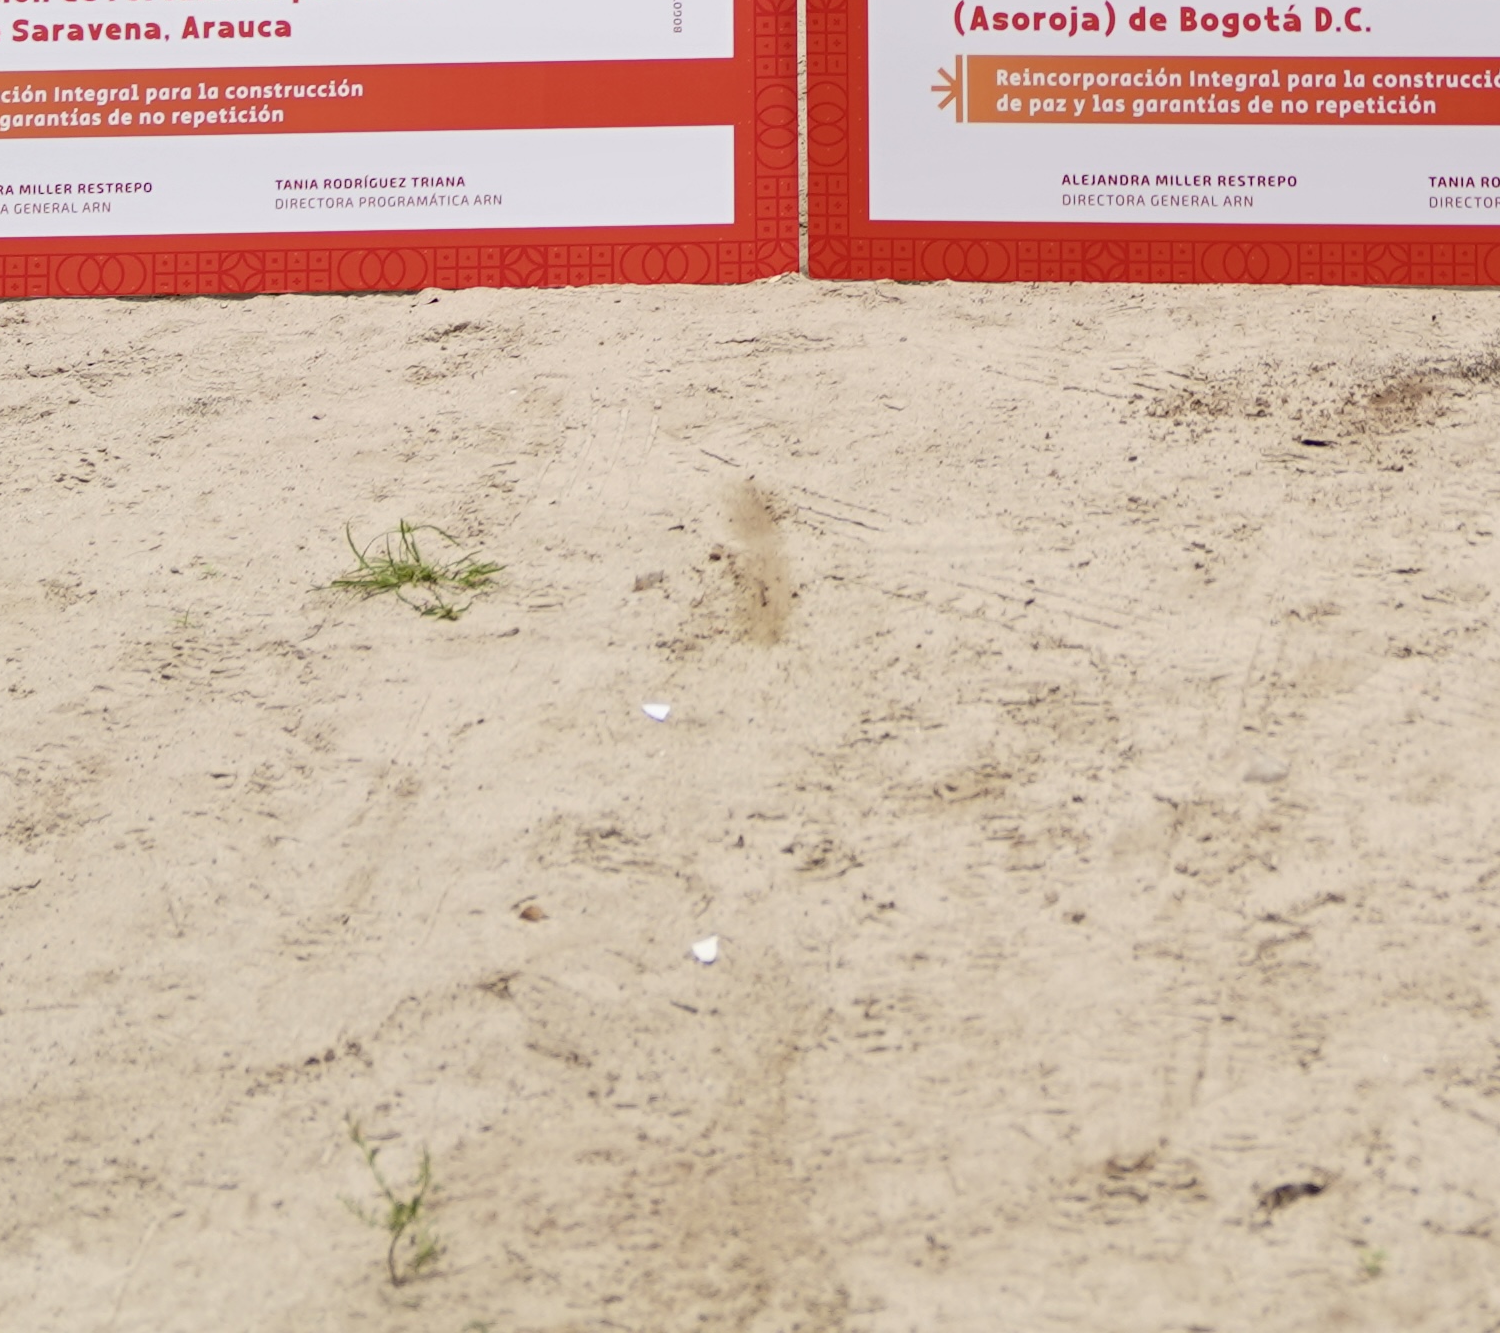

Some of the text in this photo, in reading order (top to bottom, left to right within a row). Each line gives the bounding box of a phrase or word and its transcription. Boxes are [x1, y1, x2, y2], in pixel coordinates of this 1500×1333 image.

[954, 0, 1371, 38] (Asoroja) de Bogotá D.C.
